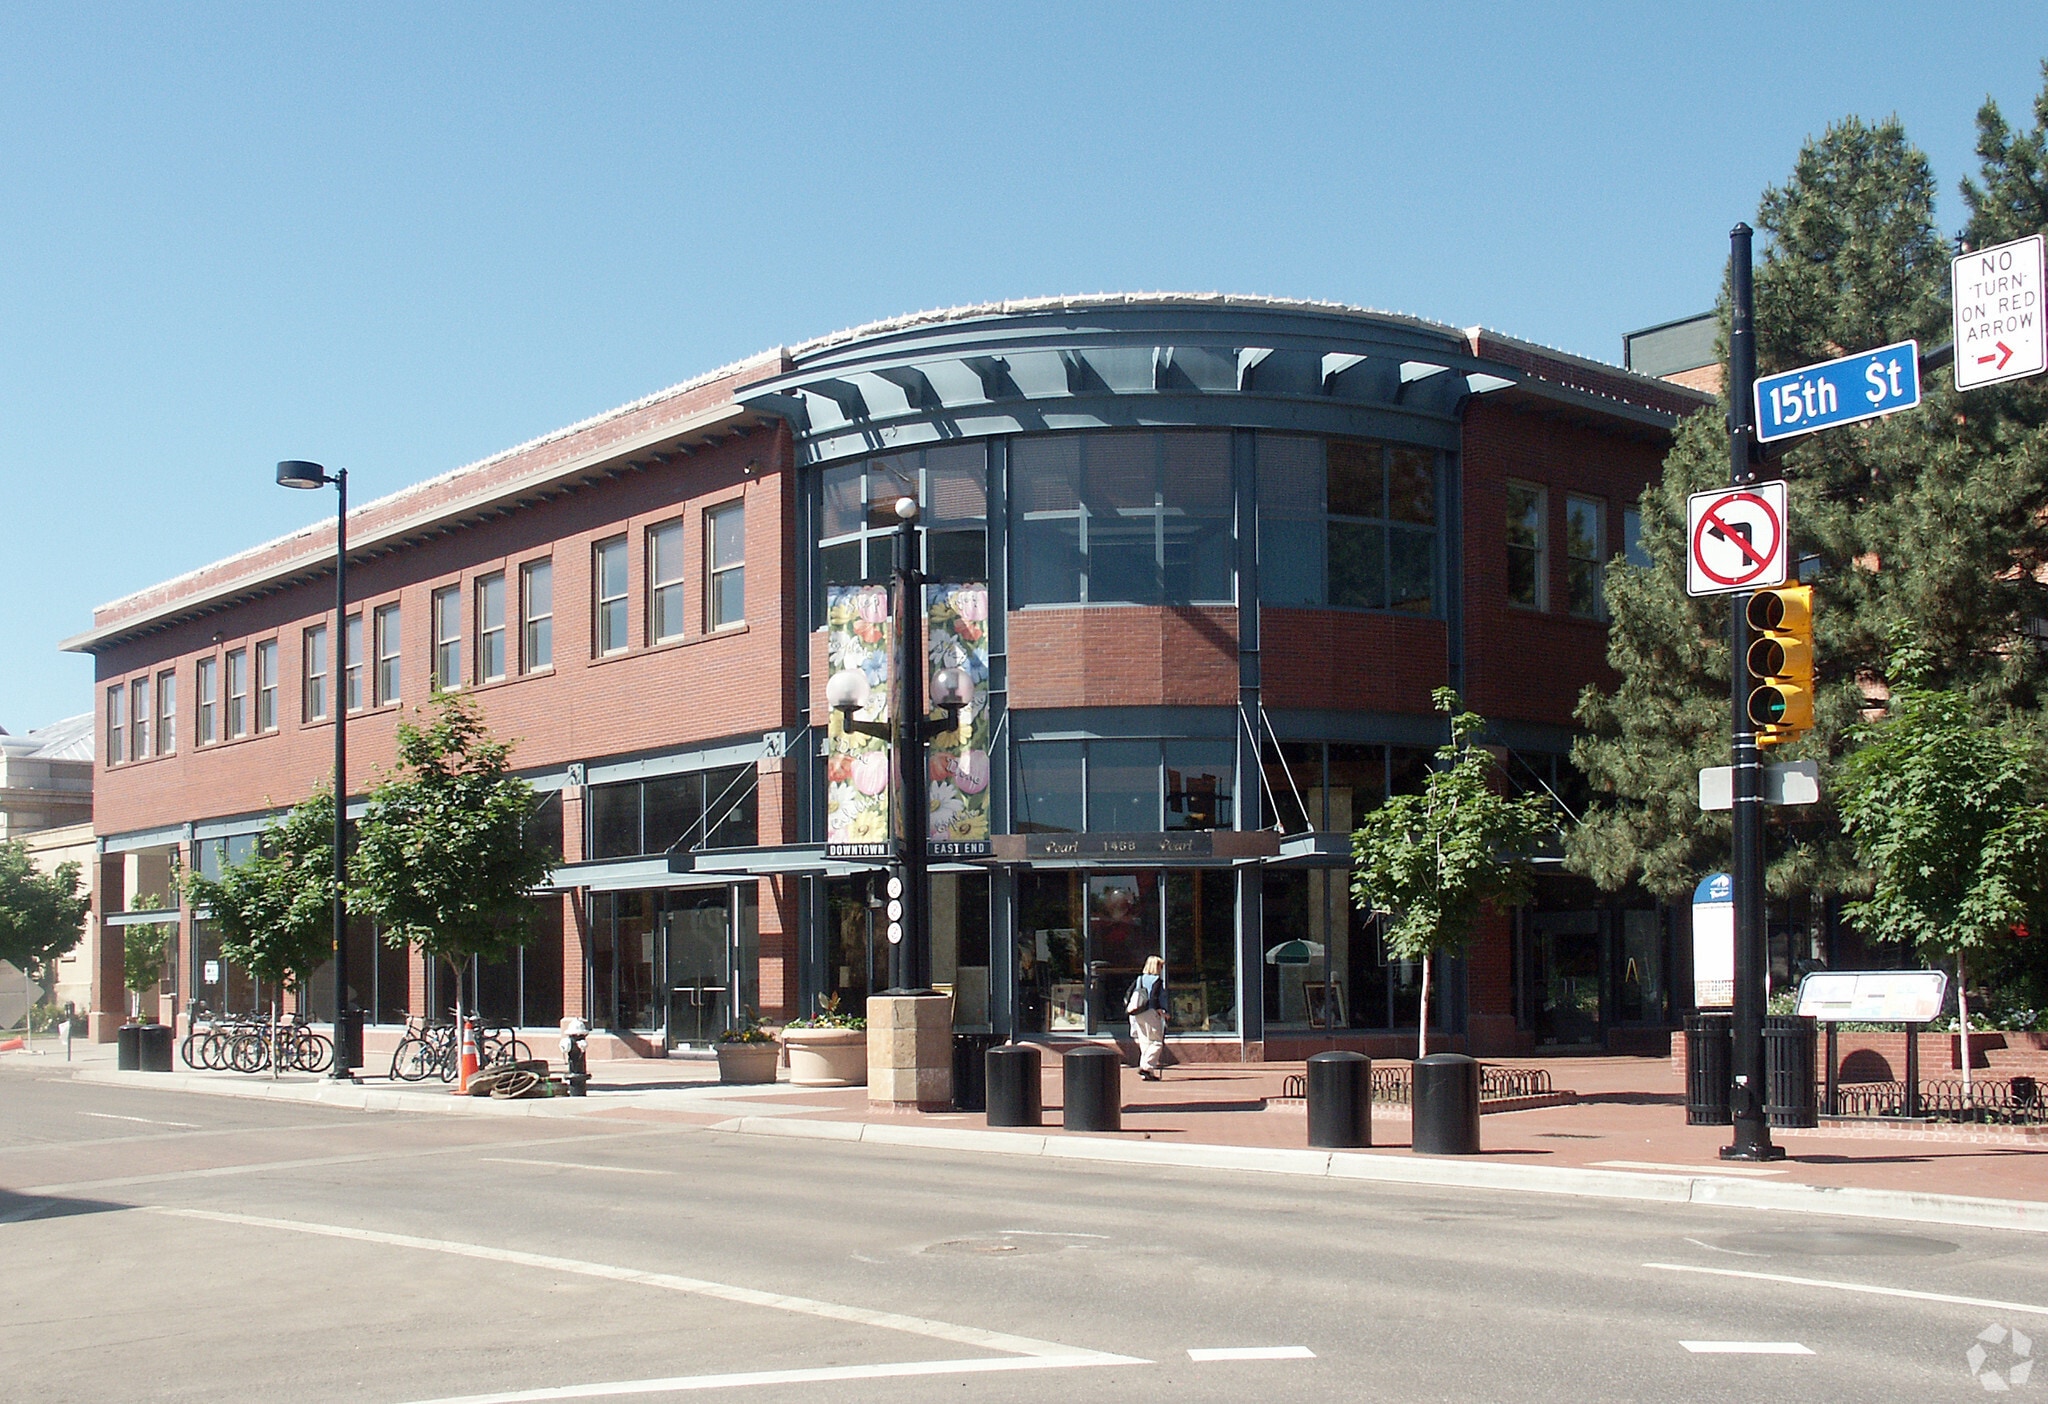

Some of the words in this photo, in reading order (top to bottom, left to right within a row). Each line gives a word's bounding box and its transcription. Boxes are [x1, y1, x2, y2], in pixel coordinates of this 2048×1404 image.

[1981, 251, 2013, 277] NO
[1974, 272, 2023, 298] TURN
[1962, 303, 1986, 323] ON
[1999, 291, 2036, 314] RED
[1967, 312, 2034, 343] ARROW
[1769, 376, 1838, 426] 15th
[1865, 358, 1904, 403] St
[829, 844, 885, 856] DOWNTOWN
[934, 844, 959, 854] EAST
[964, 843, 985, 853] END
[1045, 840, 1079, 853] Pearl
[1159, 838, 1193, 852] Pearl
